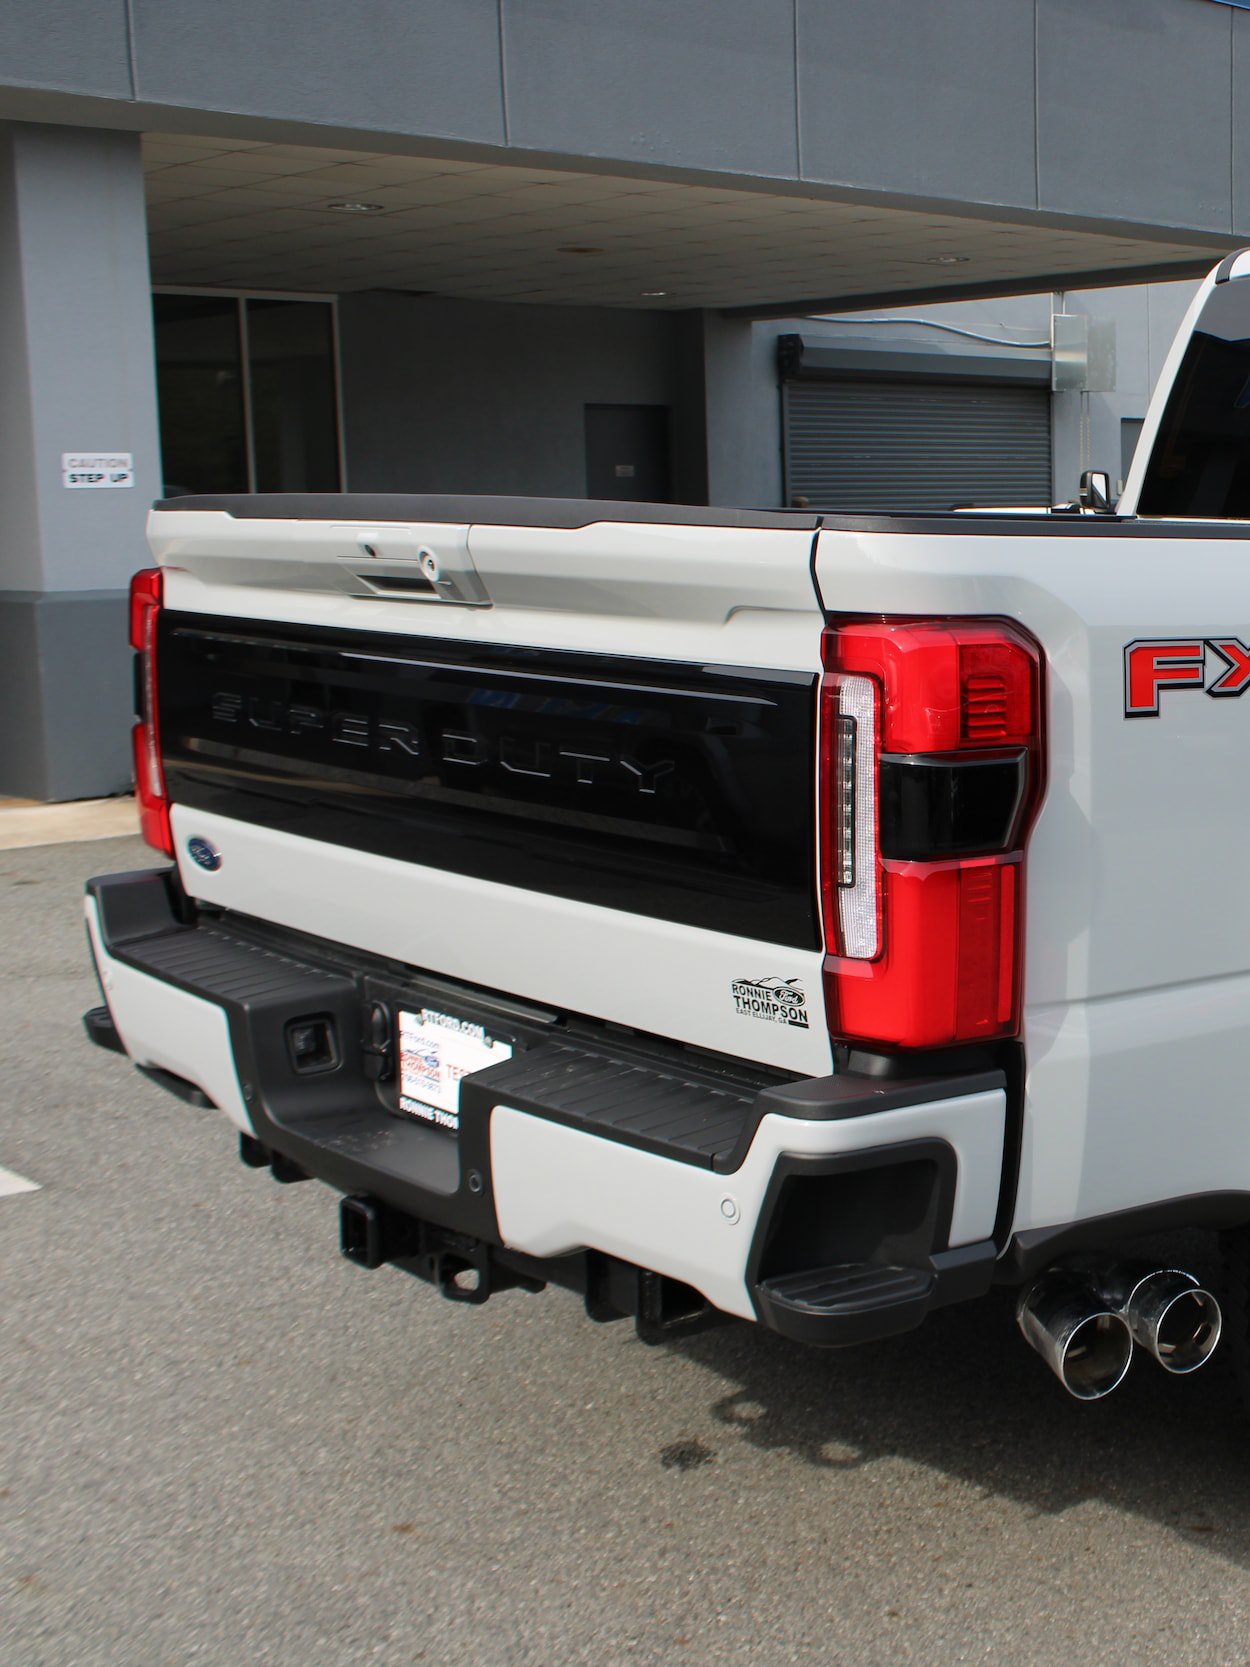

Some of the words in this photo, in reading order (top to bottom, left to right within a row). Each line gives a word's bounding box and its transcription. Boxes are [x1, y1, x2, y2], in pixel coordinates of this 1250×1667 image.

[68, 458, 128, 469] CAUTION
[68, 473, 104, 483] STEP
[110, 473, 129, 483] UP
[210, 690, 421, 757] SUPER
[440, 728, 676, 795] DUTY
[732, 984, 772, 1002] RONNIE
[777, 988, 801, 1005] Ford
[733, 995, 808, 1022] THOMPSON
[736, 1008, 751, 1017] EAST
